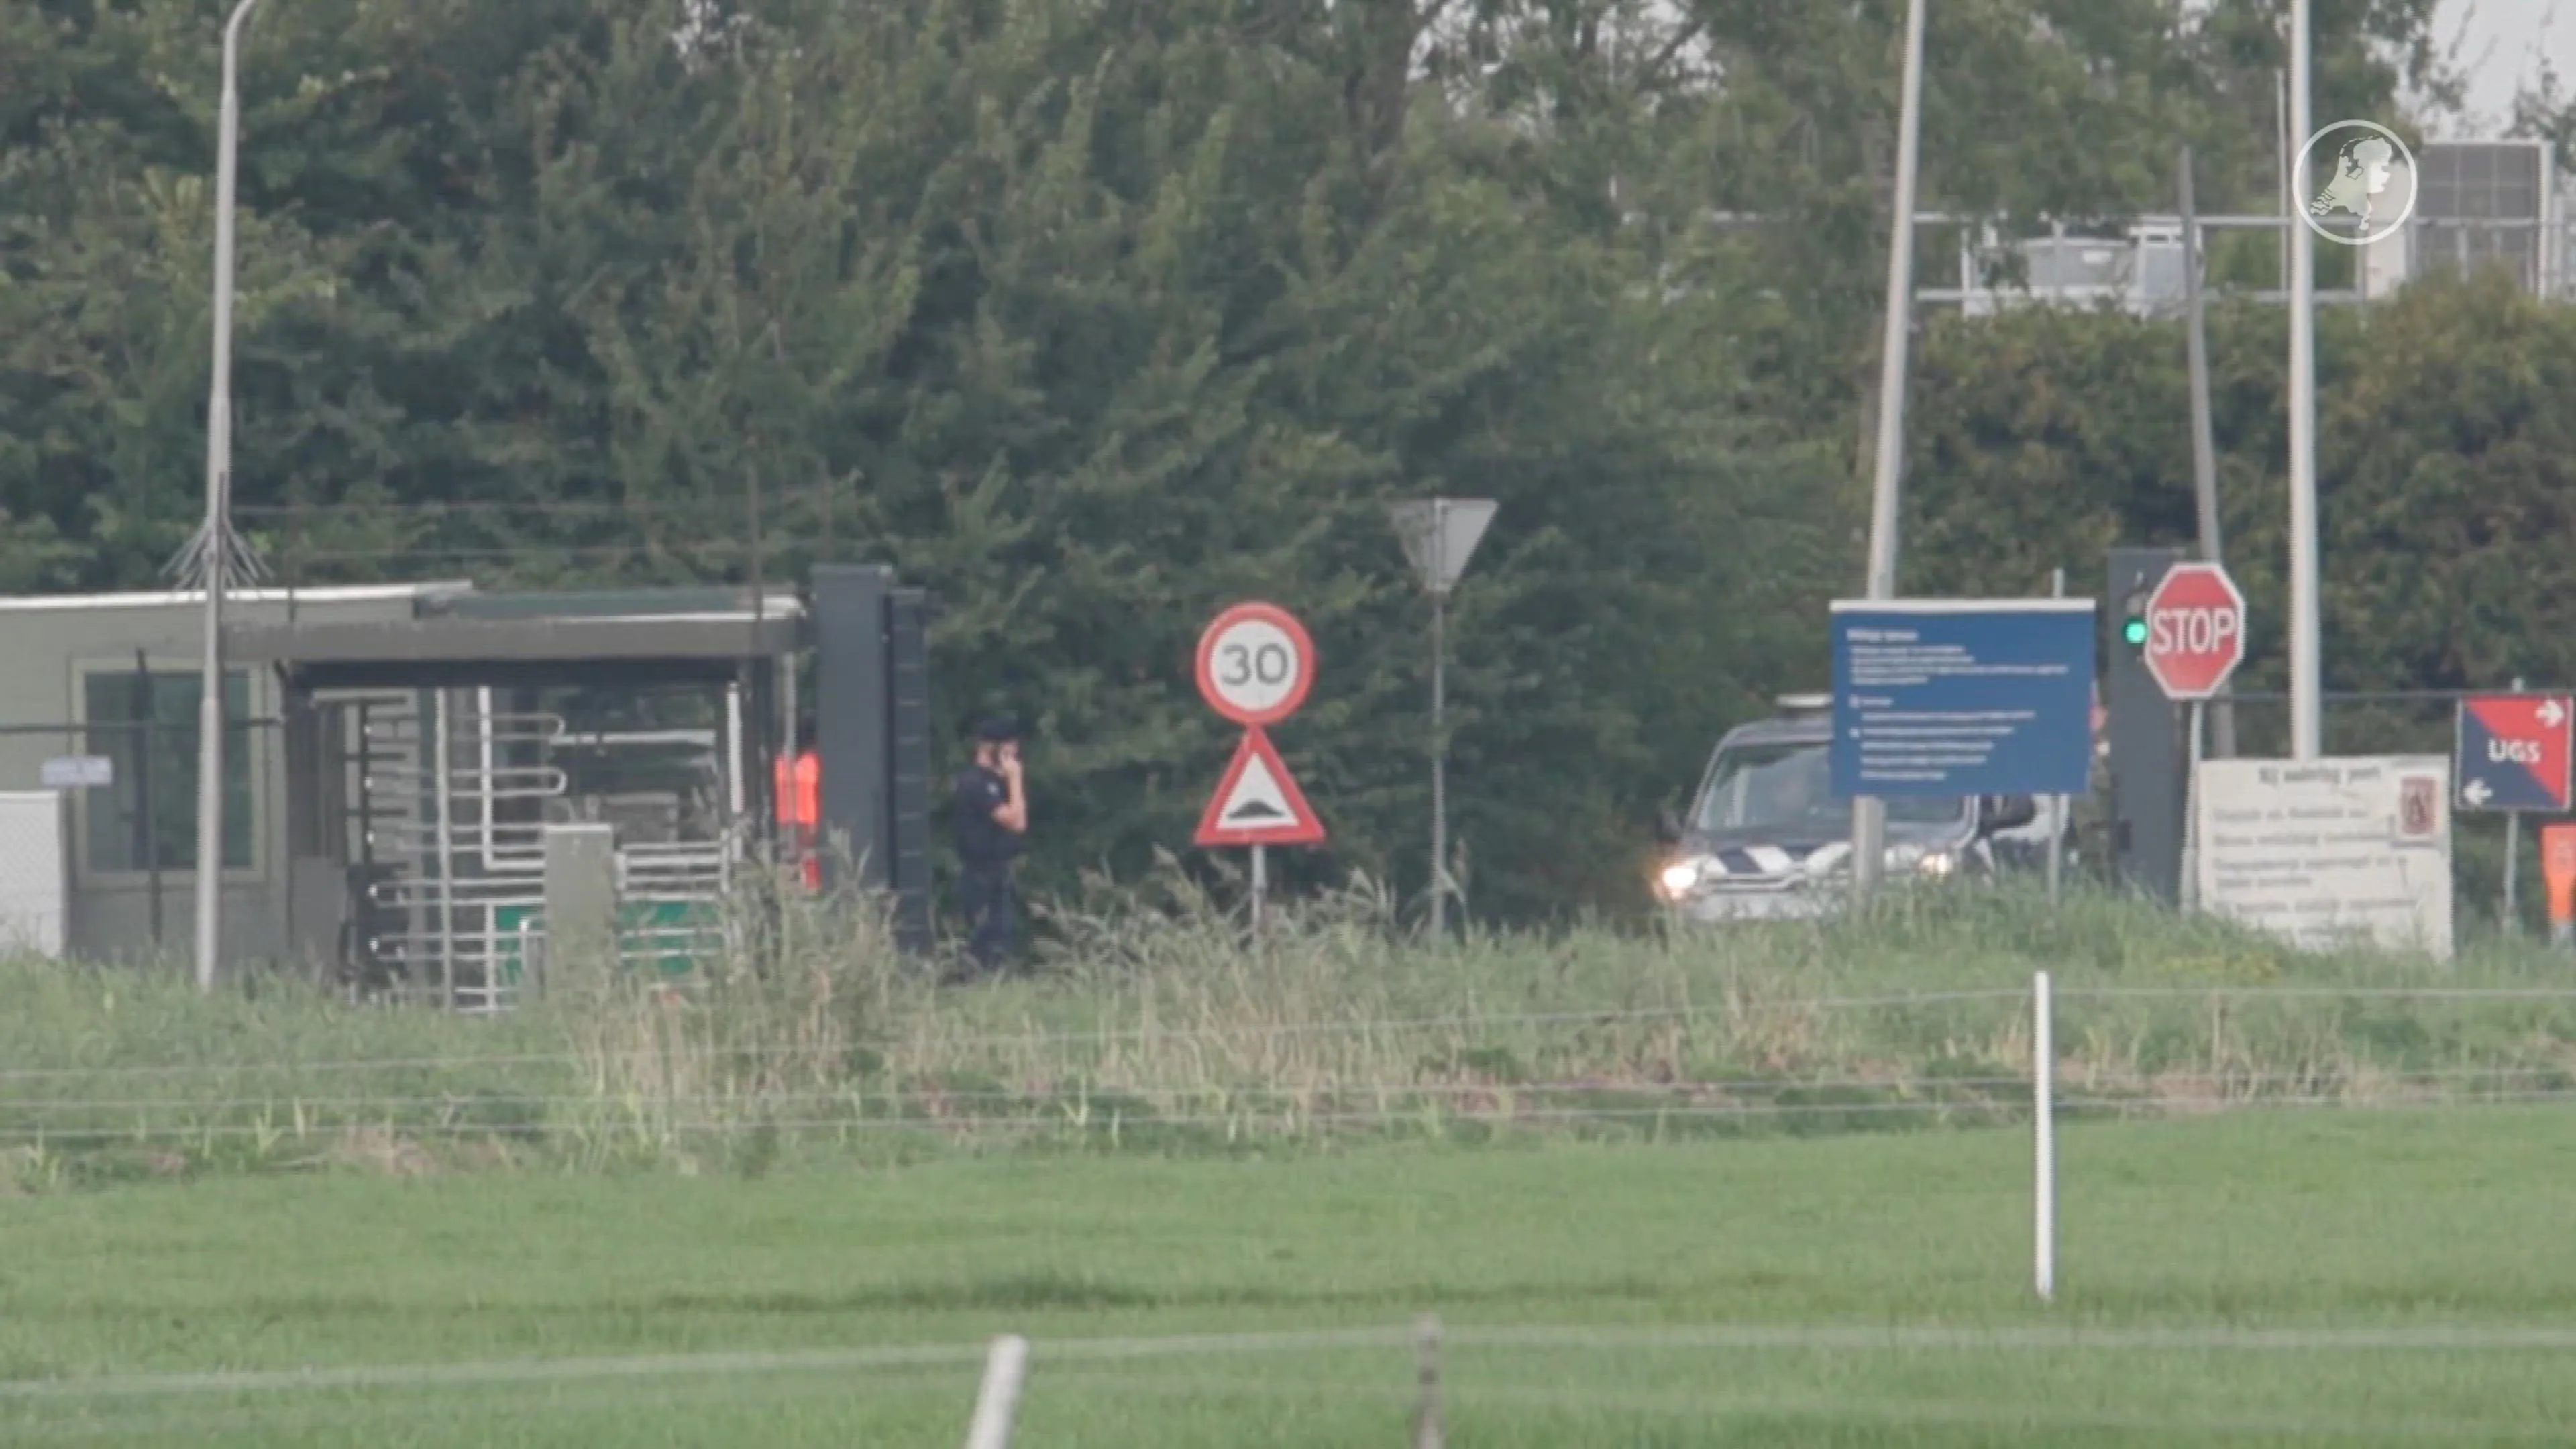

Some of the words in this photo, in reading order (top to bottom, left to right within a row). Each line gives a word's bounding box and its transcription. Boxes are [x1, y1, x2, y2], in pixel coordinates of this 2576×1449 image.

[2152, 608, 2235, 654] STOP
[1222, 643, 1289, 686] 30
[2487, 738, 2541, 763] UGS
